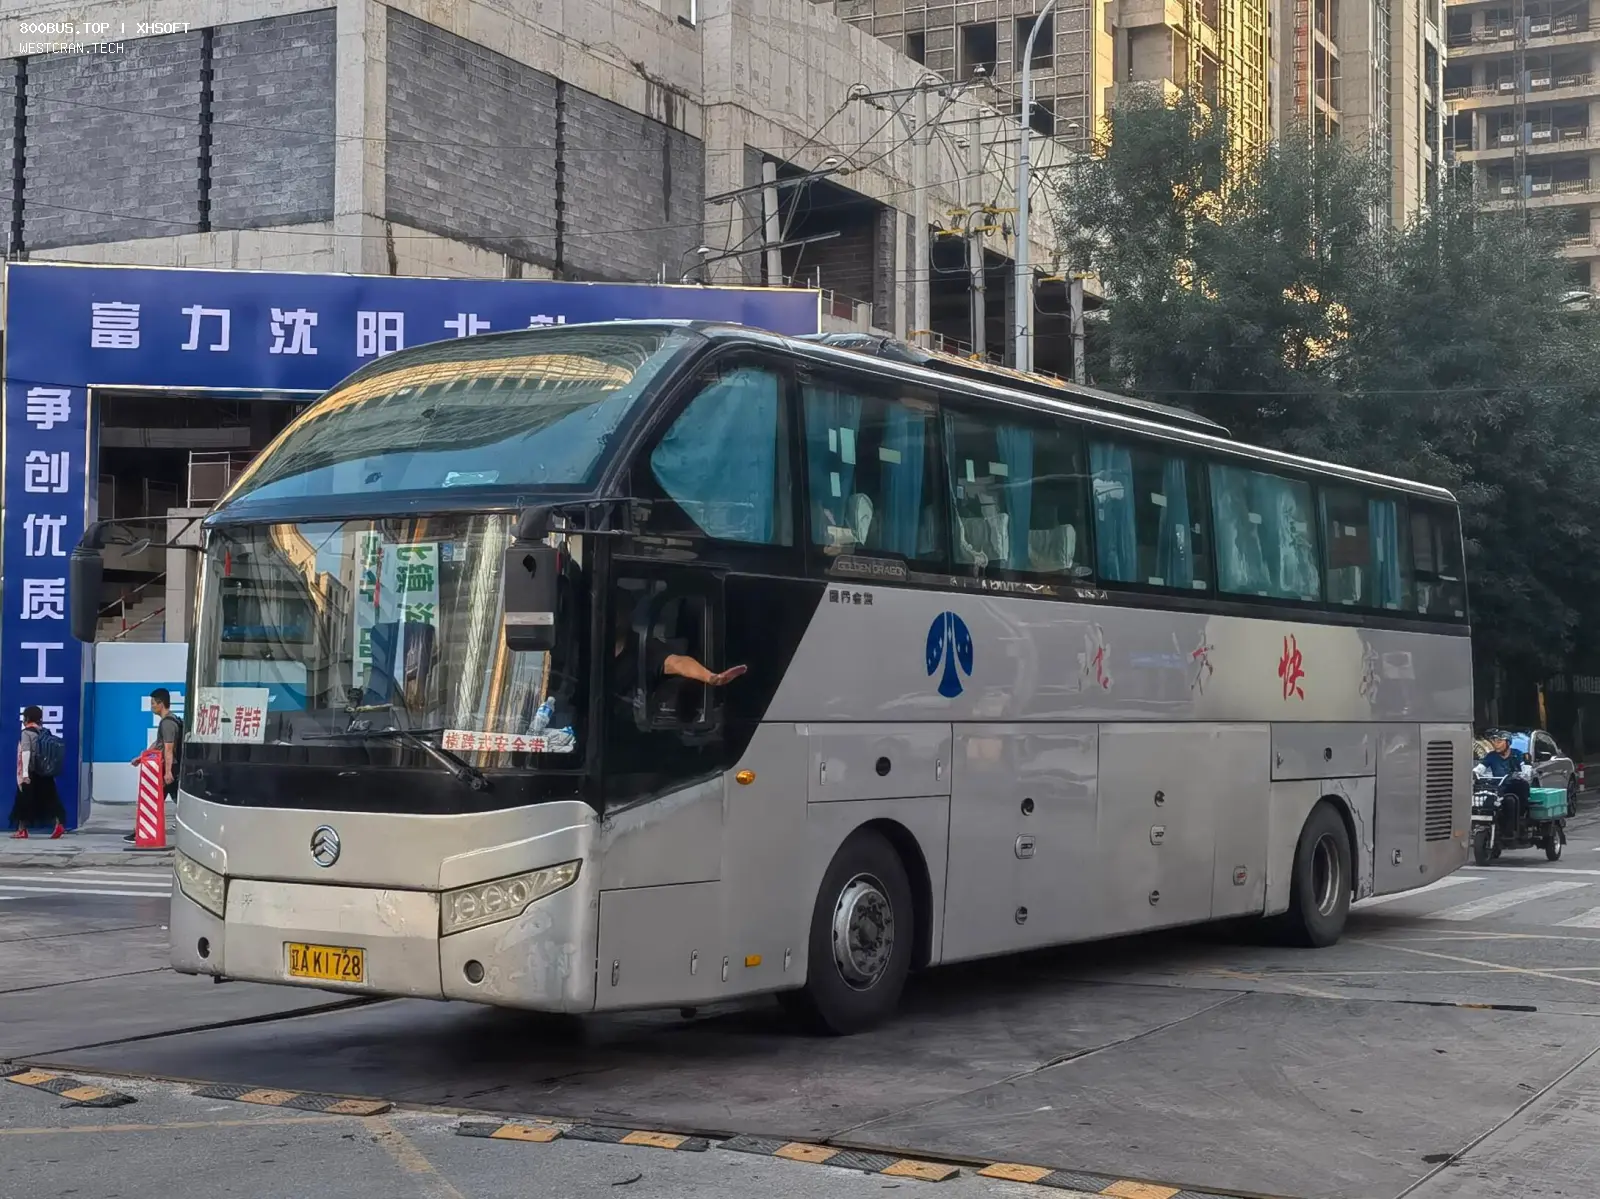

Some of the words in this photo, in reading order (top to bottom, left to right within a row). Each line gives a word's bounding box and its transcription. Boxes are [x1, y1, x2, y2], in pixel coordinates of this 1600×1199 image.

[91, 301, 742, 357] 富力沈阳北
